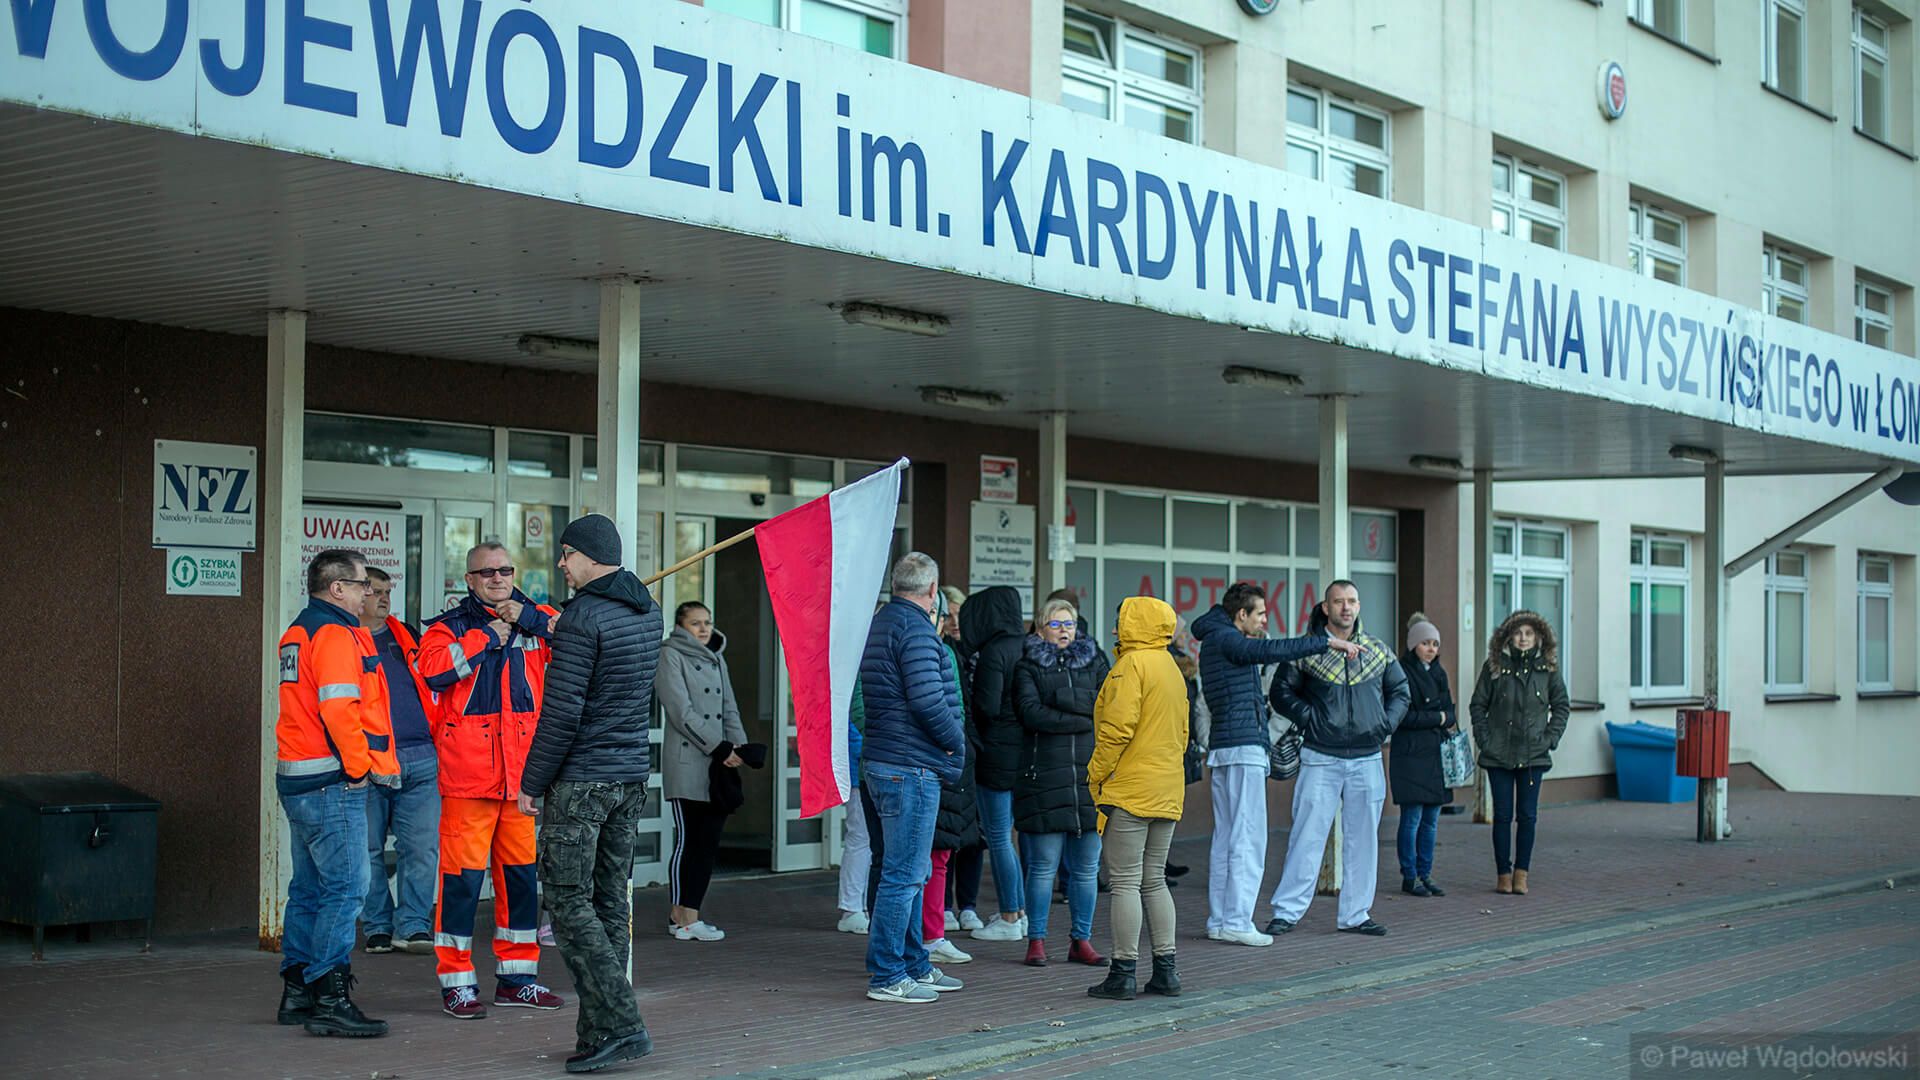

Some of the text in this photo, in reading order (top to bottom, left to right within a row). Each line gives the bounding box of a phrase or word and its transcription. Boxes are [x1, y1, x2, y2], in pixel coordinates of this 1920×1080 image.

[837, 93, 951, 238] im.
[981, 129, 1376, 326] KARDYNAŁA
[1388, 238, 1588, 374] STEFANA
[1598, 295, 1842, 428] WYSZYŃSKIEGO
[1849, 383, 1869, 433] w
[159, 462, 251, 514] NFZ
[159, 513, 193, 524] Narodowy
[195, 514, 223, 525] Fundusz
[303, 517, 390, 542] UWAGA!
[200, 559, 237, 569] SZYBKA
[200, 570, 237, 580] TERAPIA
